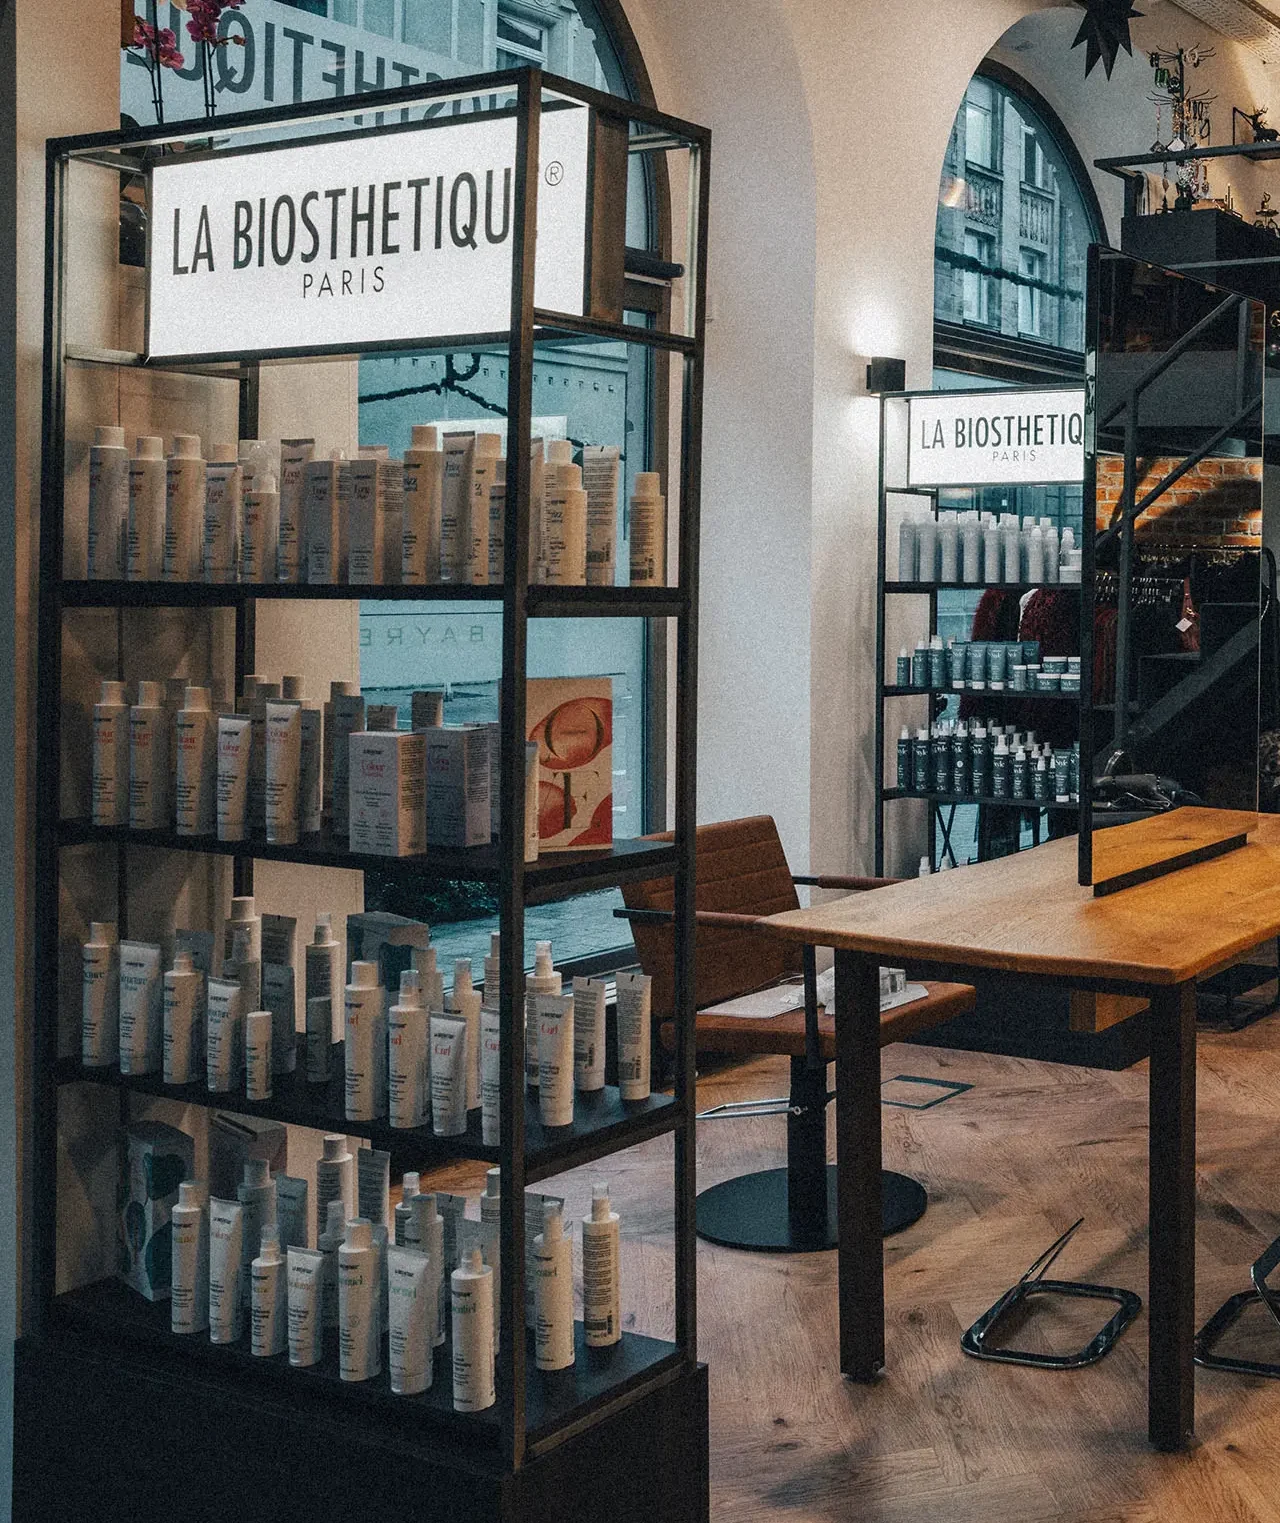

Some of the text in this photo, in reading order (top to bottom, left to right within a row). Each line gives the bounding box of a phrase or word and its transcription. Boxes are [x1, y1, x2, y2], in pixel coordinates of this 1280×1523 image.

[172, 204, 214, 276] LA
[232, 167, 513, 271] BIOSTHETIQU
[302, 265, 387, 299] PARIS
[921, 413, 1083, 450] LA BIOSTHETIQ
[992, 450, 1038, 463] PARIS
